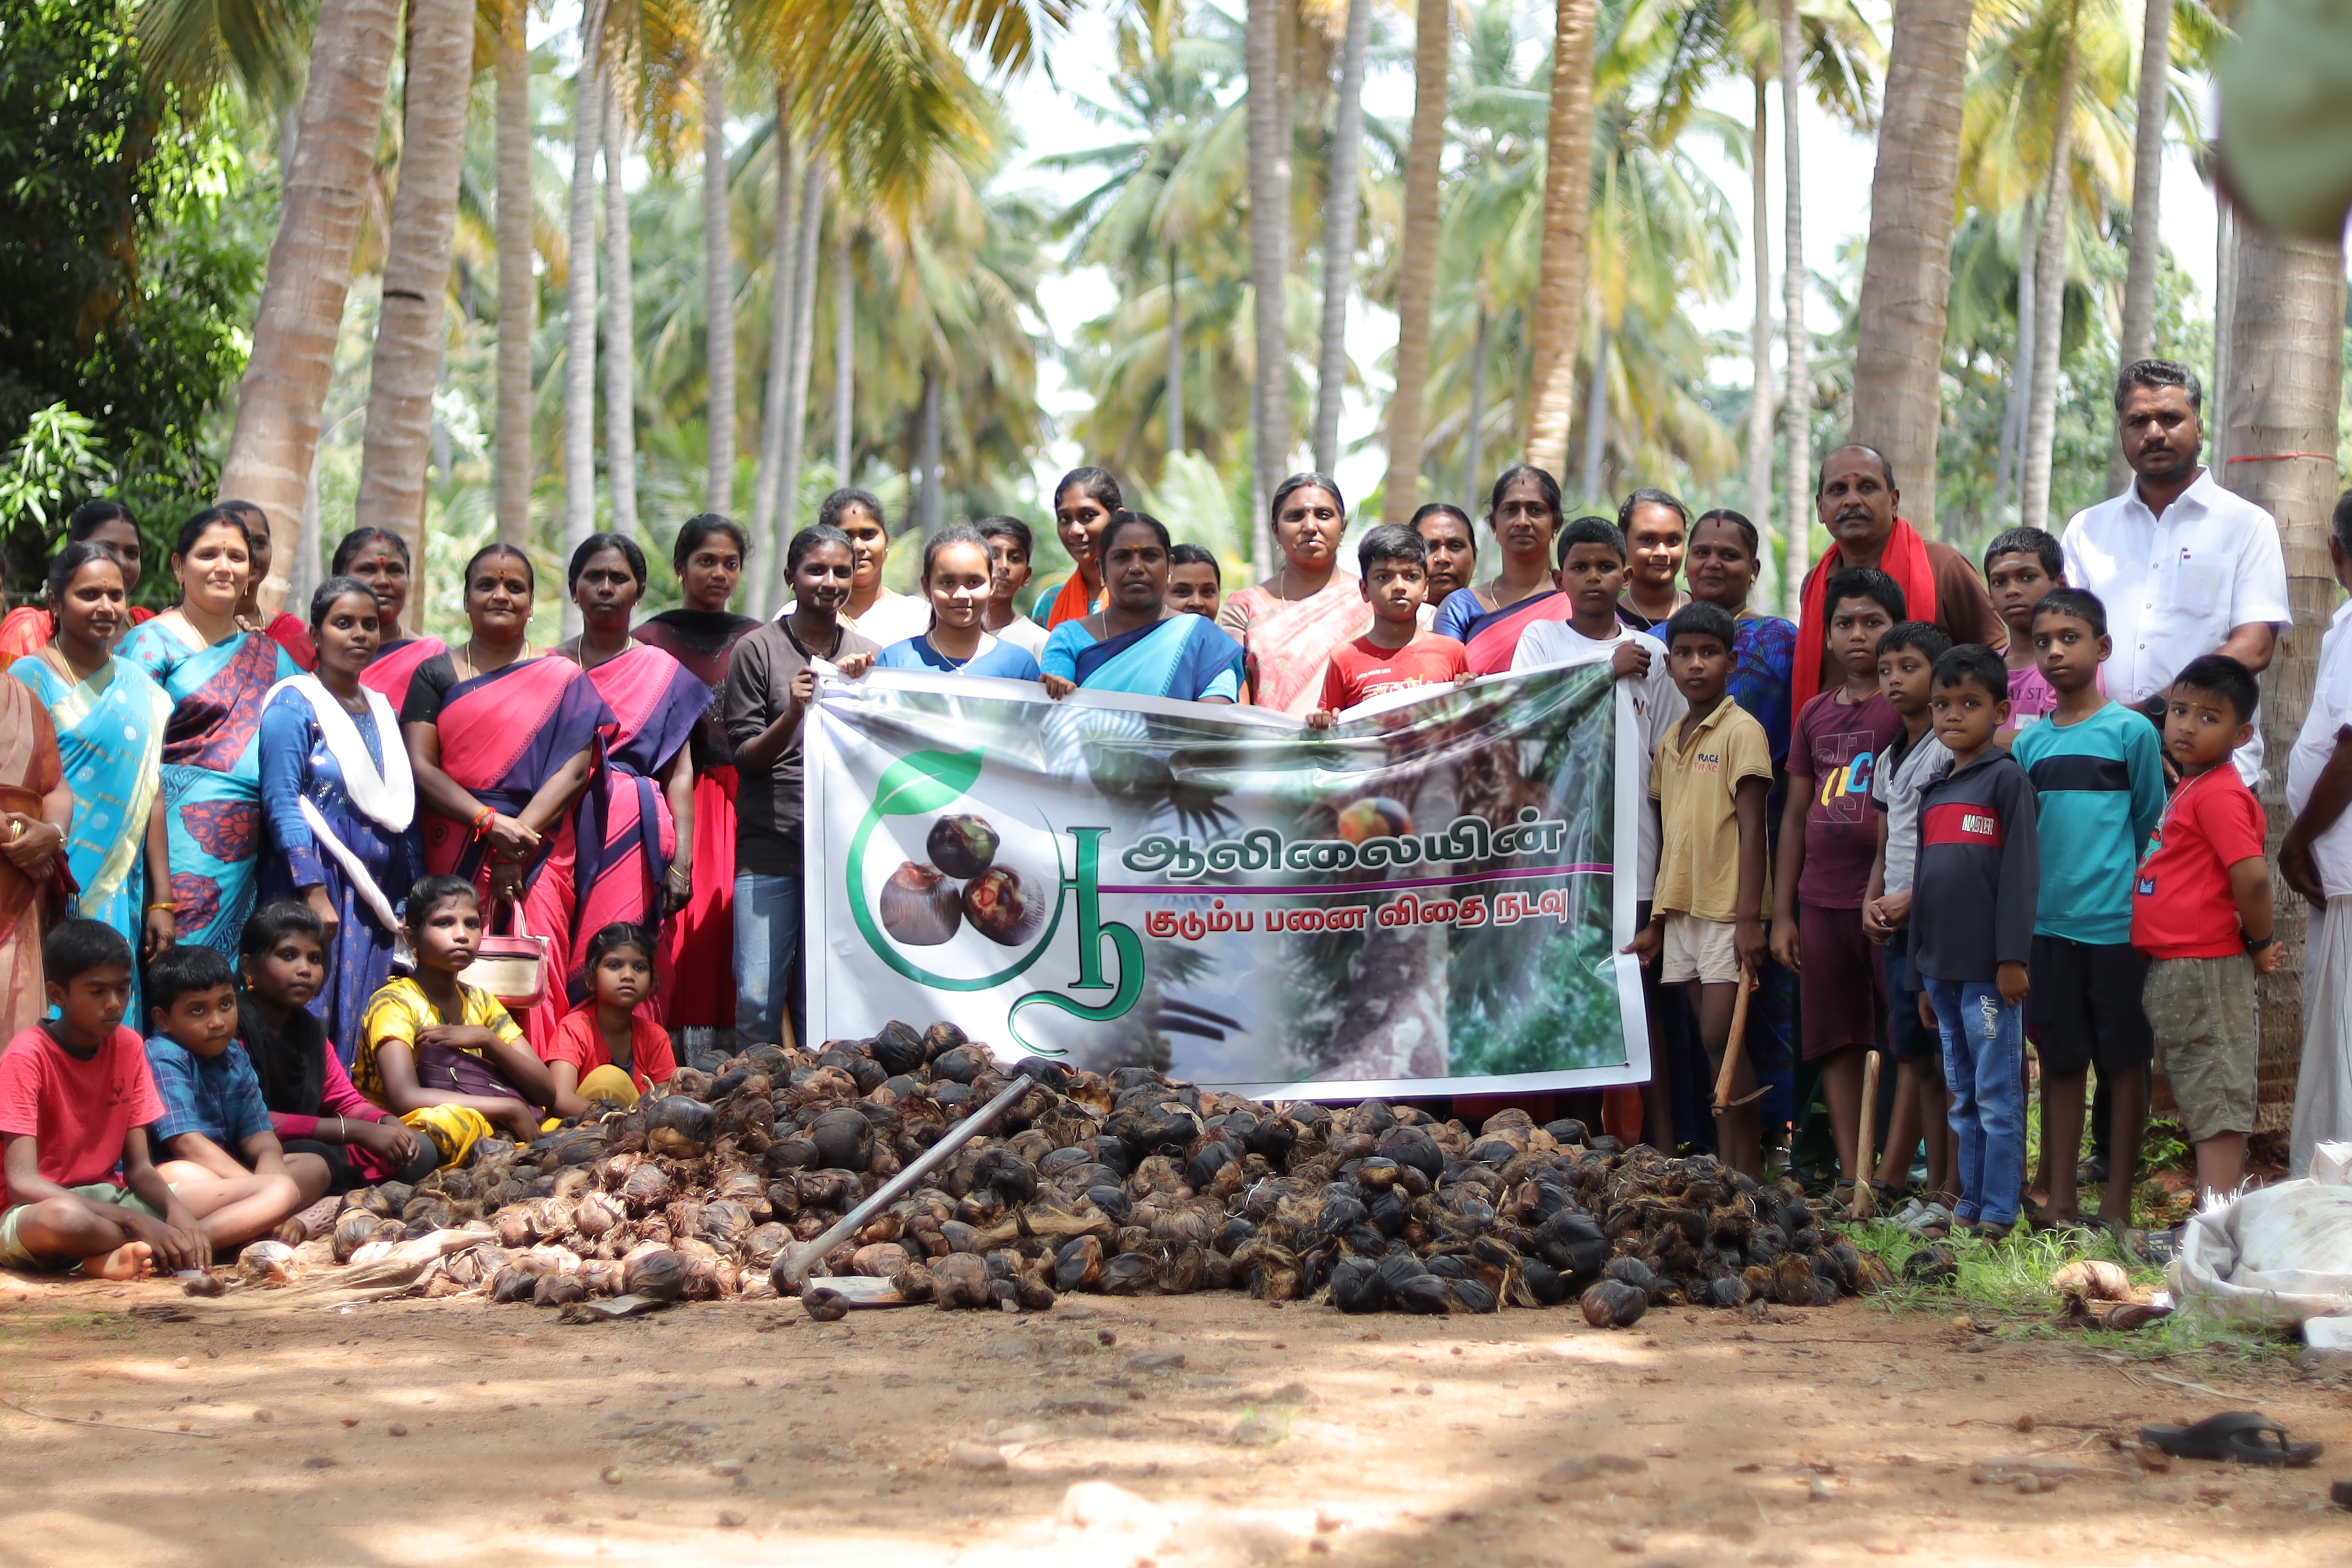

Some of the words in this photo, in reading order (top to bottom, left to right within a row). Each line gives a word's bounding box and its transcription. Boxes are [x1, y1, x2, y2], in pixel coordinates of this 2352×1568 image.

[1698, 753, 1719, 763] RACE
[1121, 806, 1566, 878] ஆலிலையின்
[1962, 814, 1994, 835] MASTER
[1145, 898, 1254, 941] குடும்ப
[1265, 905, 1367, 933] பனை
[1378, 891, 1485, 928] விதை
[1495, 888, 1569, 924] நடவு
